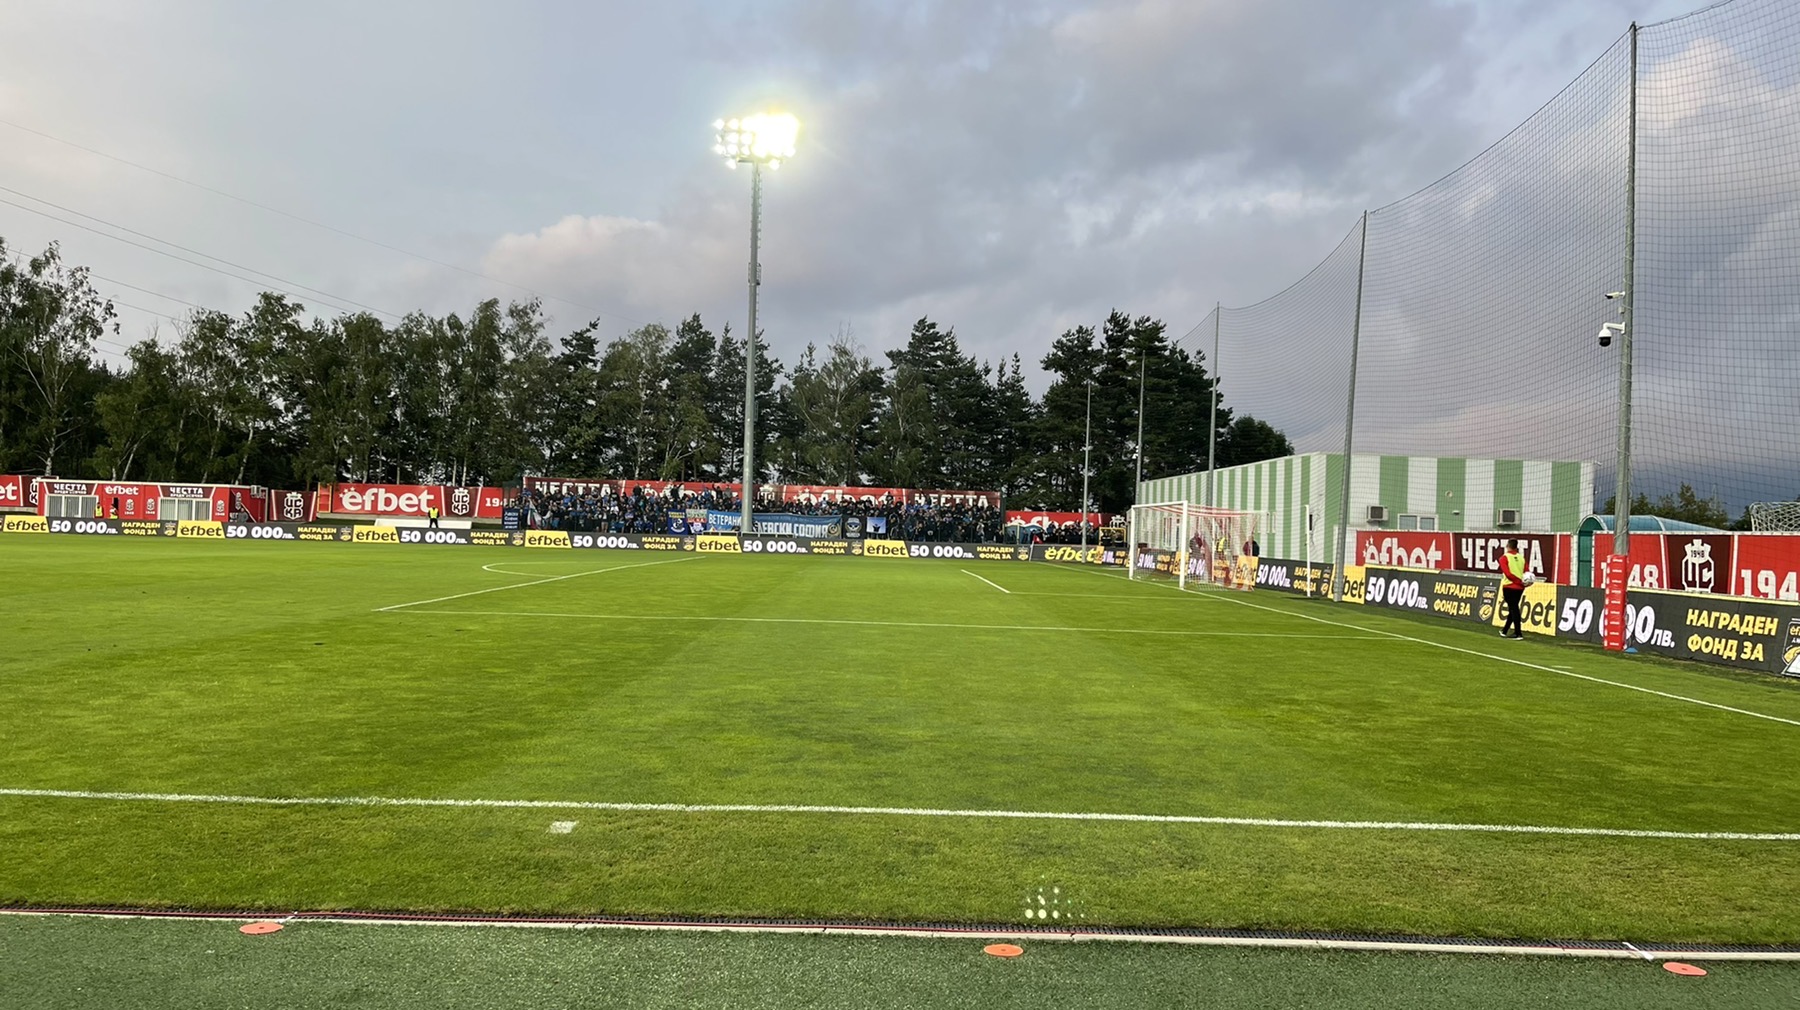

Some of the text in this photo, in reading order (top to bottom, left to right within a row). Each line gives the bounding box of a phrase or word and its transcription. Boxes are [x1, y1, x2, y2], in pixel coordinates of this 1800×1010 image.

[53, 483, 87, 491] ЧЕСТТА
[105, 485, 139, 495] efbet
[342, 487, 435, 513] efbet
[6, 520, 47, 532] efbet
[50, 520, 71, 532] 50
[180, 525, 222, 537] efbet
[226, 525, 248, 538] 50
[355, 530, 397, 541] efbet
[400, 530, 421, 543] 50
[528, 535, 569, 546] efbet
[572, 535, 593, 547] 50
[698, 540, 739, 552] efbet
[743, 540, 763, 552] 50
[866, 545, 906, 556] efbet
[910, 545, 930, 557] 50
[1256, 564, 1269, 585] 50
[1365, 576, 1386, 603] 50
[1434, 582, 1479, 599] НАГРАДЕН
[1433, 599, 1471, 616] ФОНД ЗА
[1498, 595, 1555, 628] ebet
[1558, 598, 1594, 634] 50
[1686, 608, 1779, 636] НАГРАДЕН
[1687, 634, 1765, 662] ФОНД ЗА
